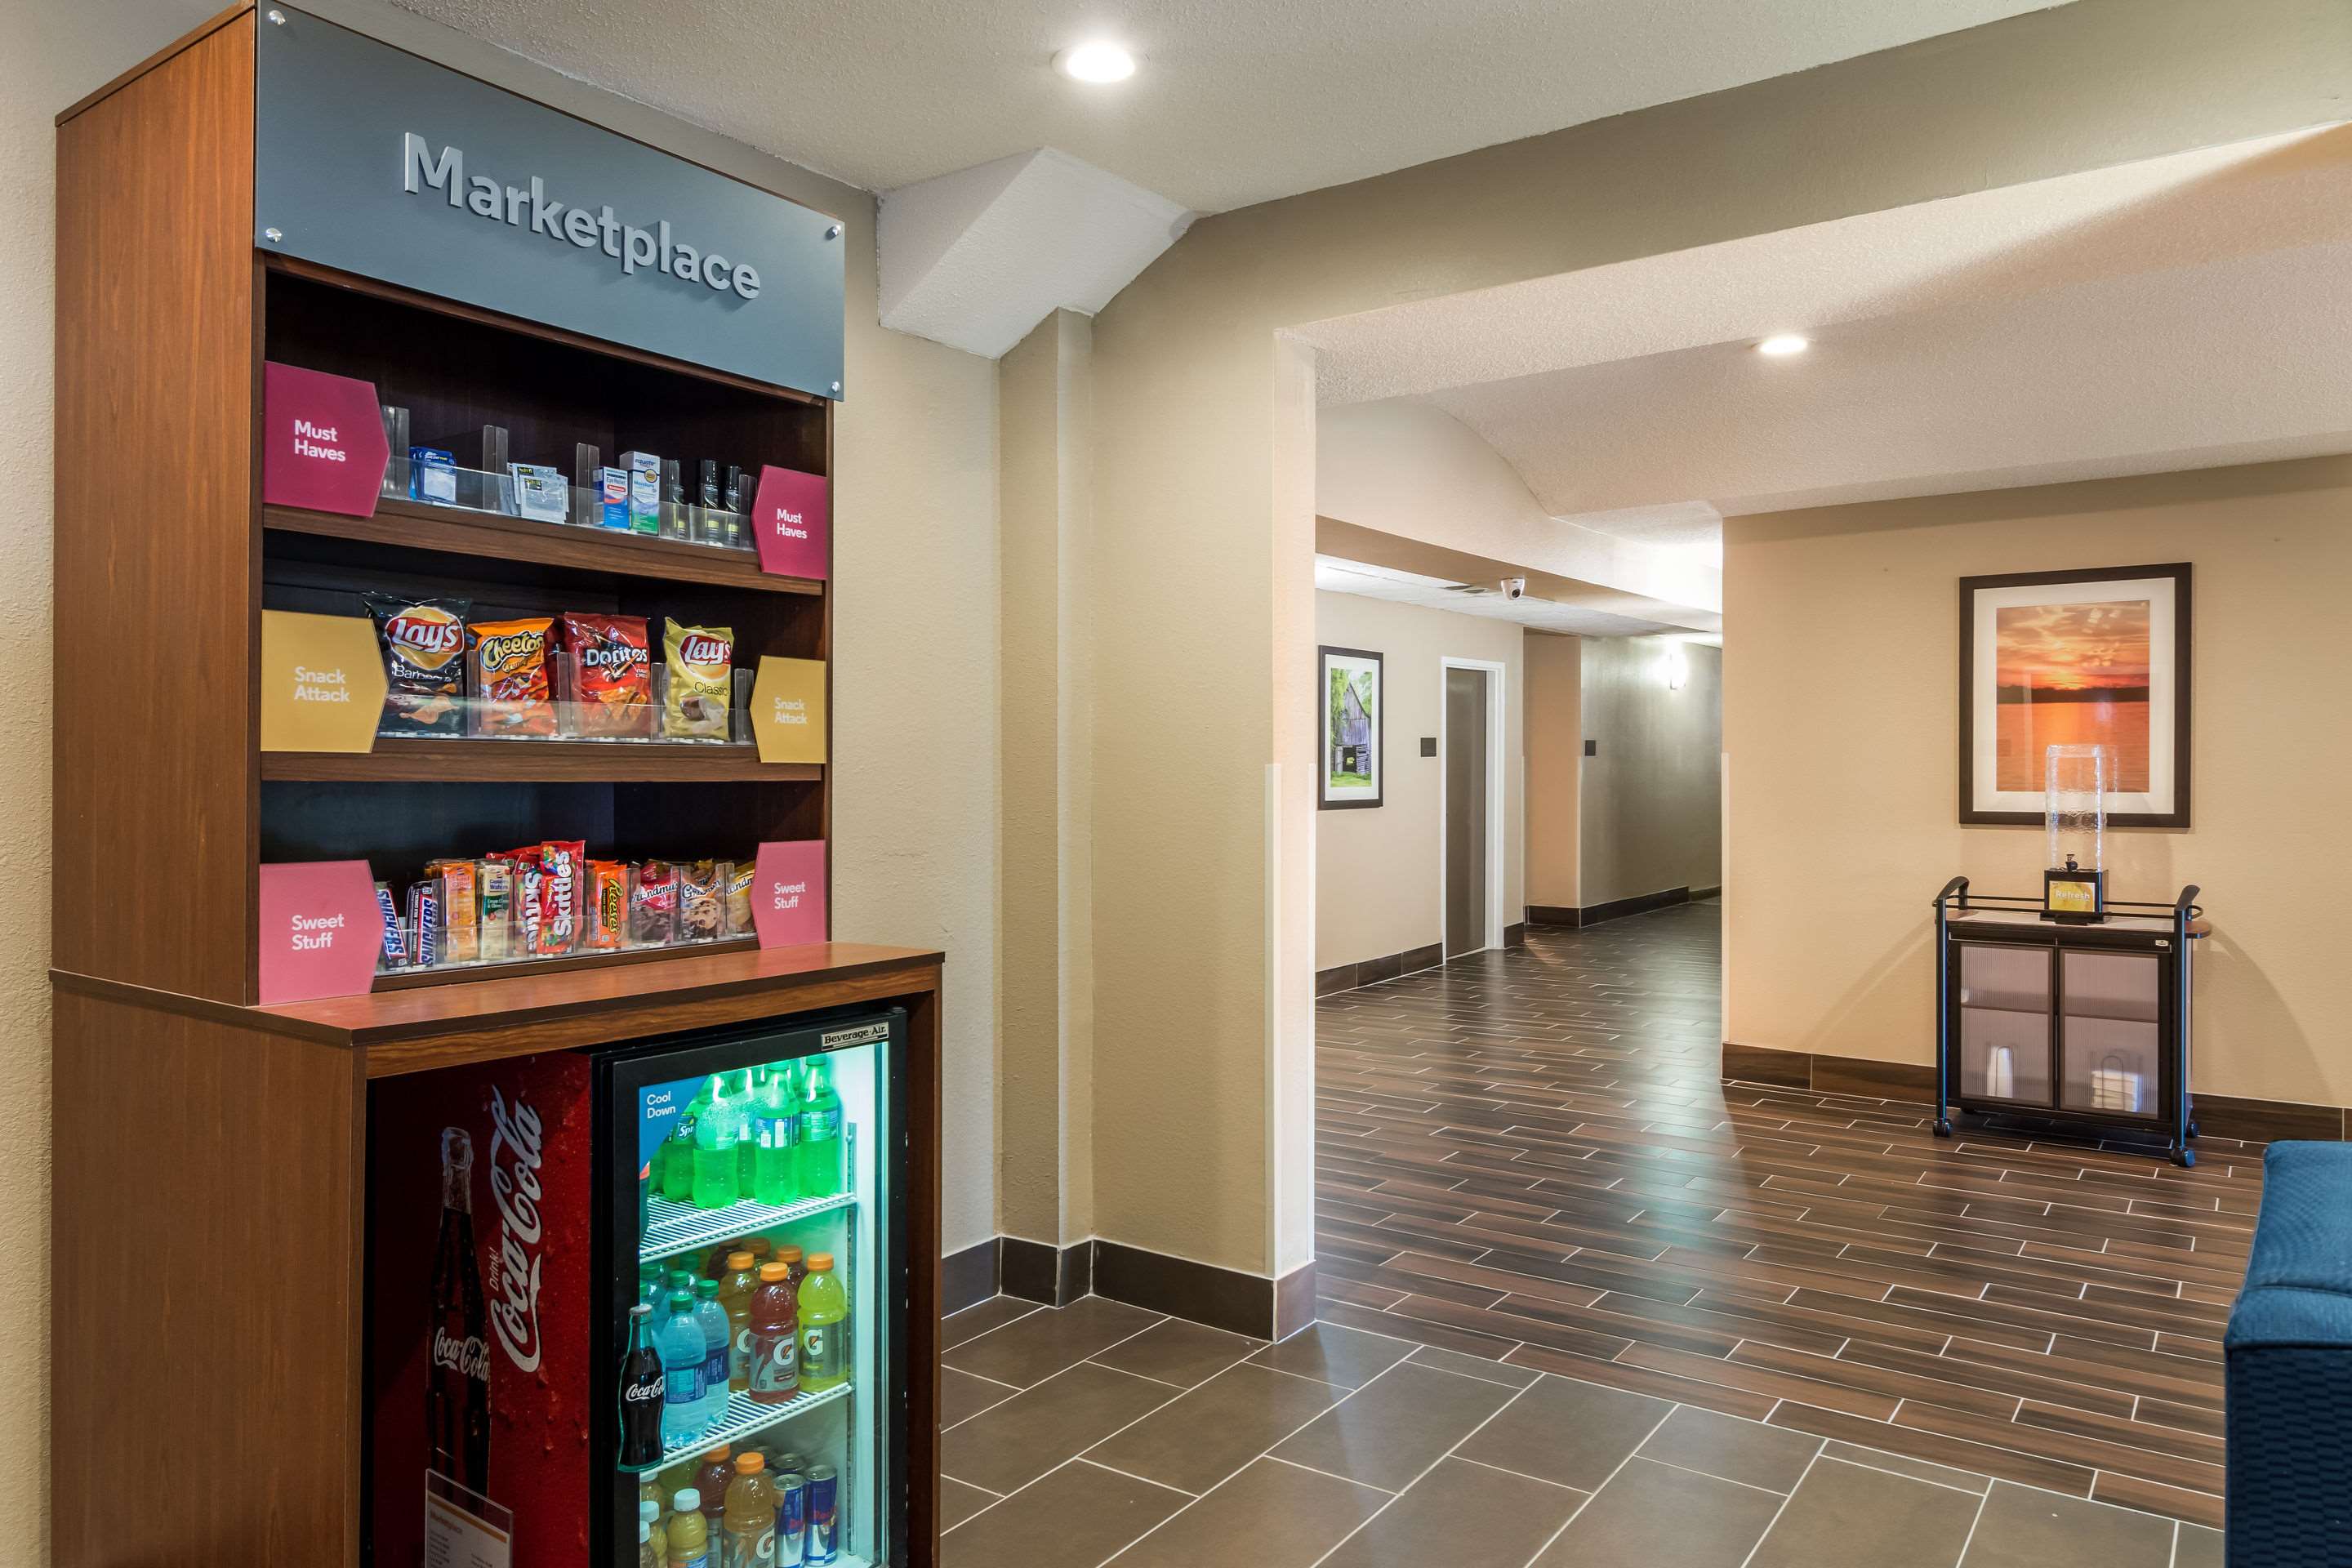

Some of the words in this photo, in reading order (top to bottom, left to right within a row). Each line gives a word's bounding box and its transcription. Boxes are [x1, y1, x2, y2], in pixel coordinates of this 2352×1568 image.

[404, 131, 761, 300] Marketplace
[294, 419, 338, 442] Must
[294, 439, 346, 462] Haves
[777, 508, 803, 524] Must
[777, 522, 808, 539] Haves
[392, 618, 460, 653] Lay's
[586, 648, 648, 667] Doritos
[684, 636, 732, 666] Lay's
[294, 666, 347, 684] Snack
[294, 684, 351, 703] Attack
[694, 681, 728, 696] Classic
[774, 697, 805, 710] Snack
[774, 711, 808, 724] Attack
[554, 850, 572, 937] Skittles
[774, 882, 806, 894] Sweet
[774, 896, 799, 909] Stuff
[292, 913, 345, 930] Sweet
[421, 898, 438, 964] SNICKERS
[292, 932, 333, 951] Stuff
[646, 1090, 671, 1106] Cool
[647, 1106, 676, 1119] Down
[489, 1247, 500, 1292] Drink!
